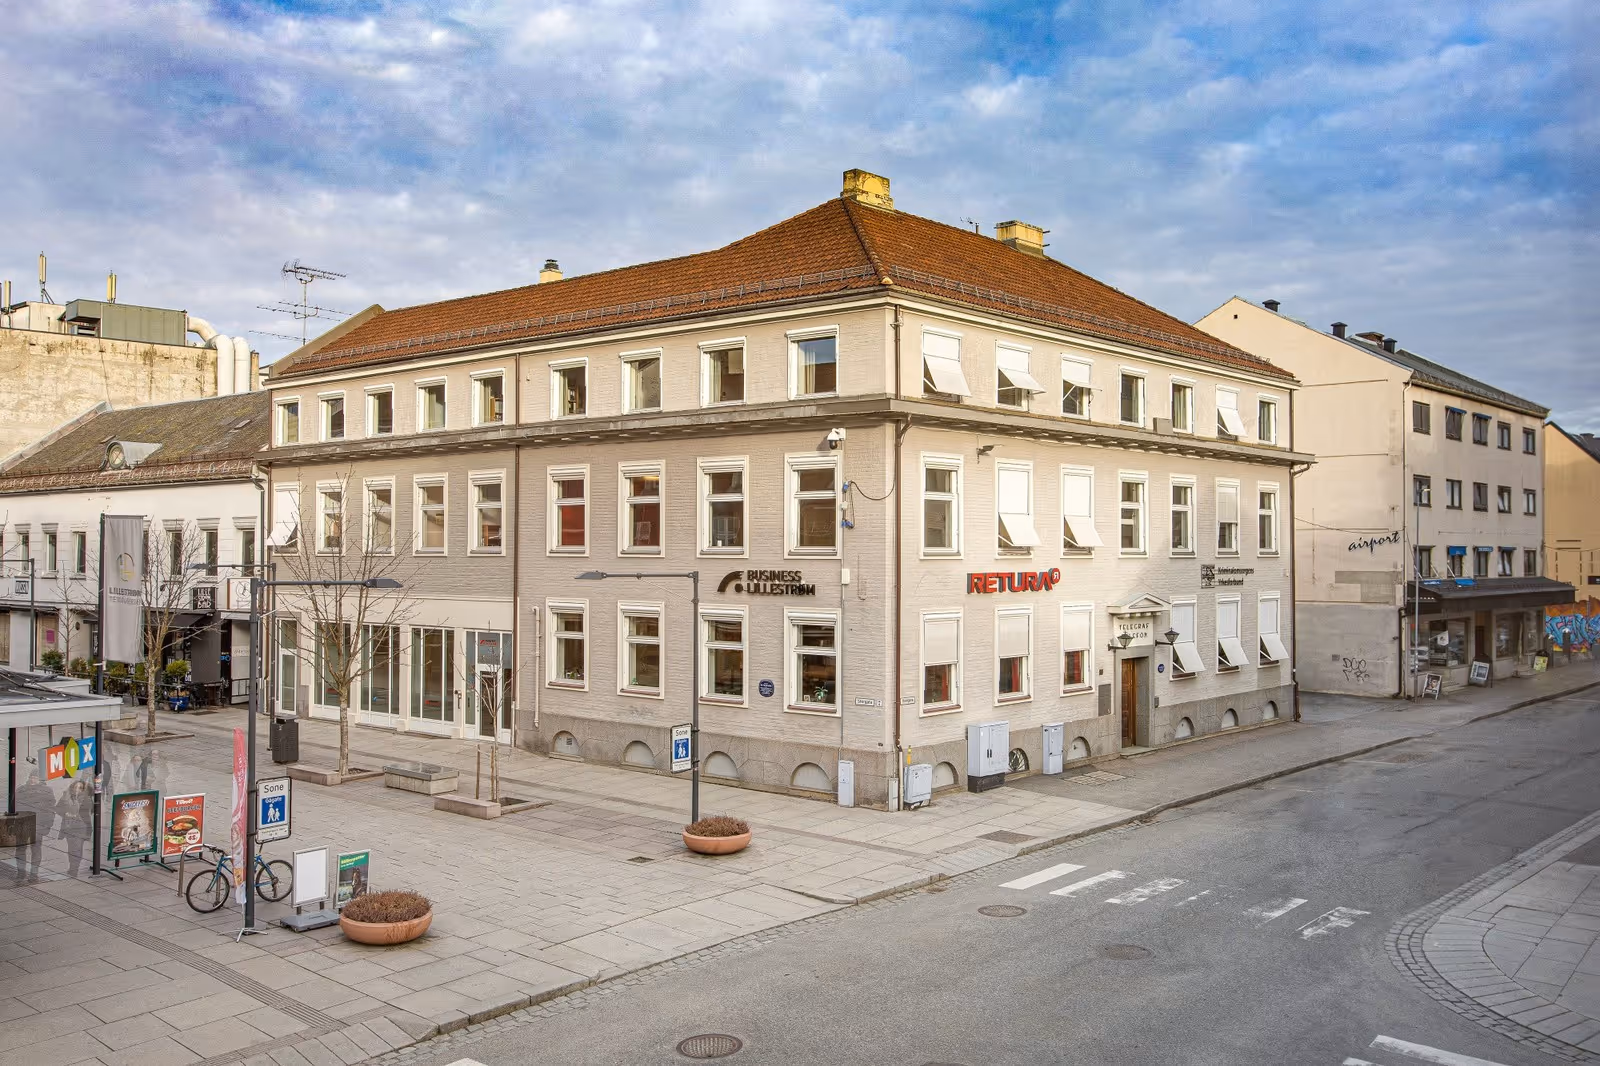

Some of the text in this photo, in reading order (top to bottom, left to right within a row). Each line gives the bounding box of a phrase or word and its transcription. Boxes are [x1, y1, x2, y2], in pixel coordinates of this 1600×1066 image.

[1348, 530, 1401, 554] airport
[747, 570, 802, 582] BUSINESS
[746, 582, 816, 596] LILLESTRØM
[967, 572, 1053, 594] RETURA
[1119, 622, 1150, 631] TELEGRAF
[675, 729, 688, 737] Sone
[50, 742, 94, 774] MIX
[263, 783, 284, 794] Sone
